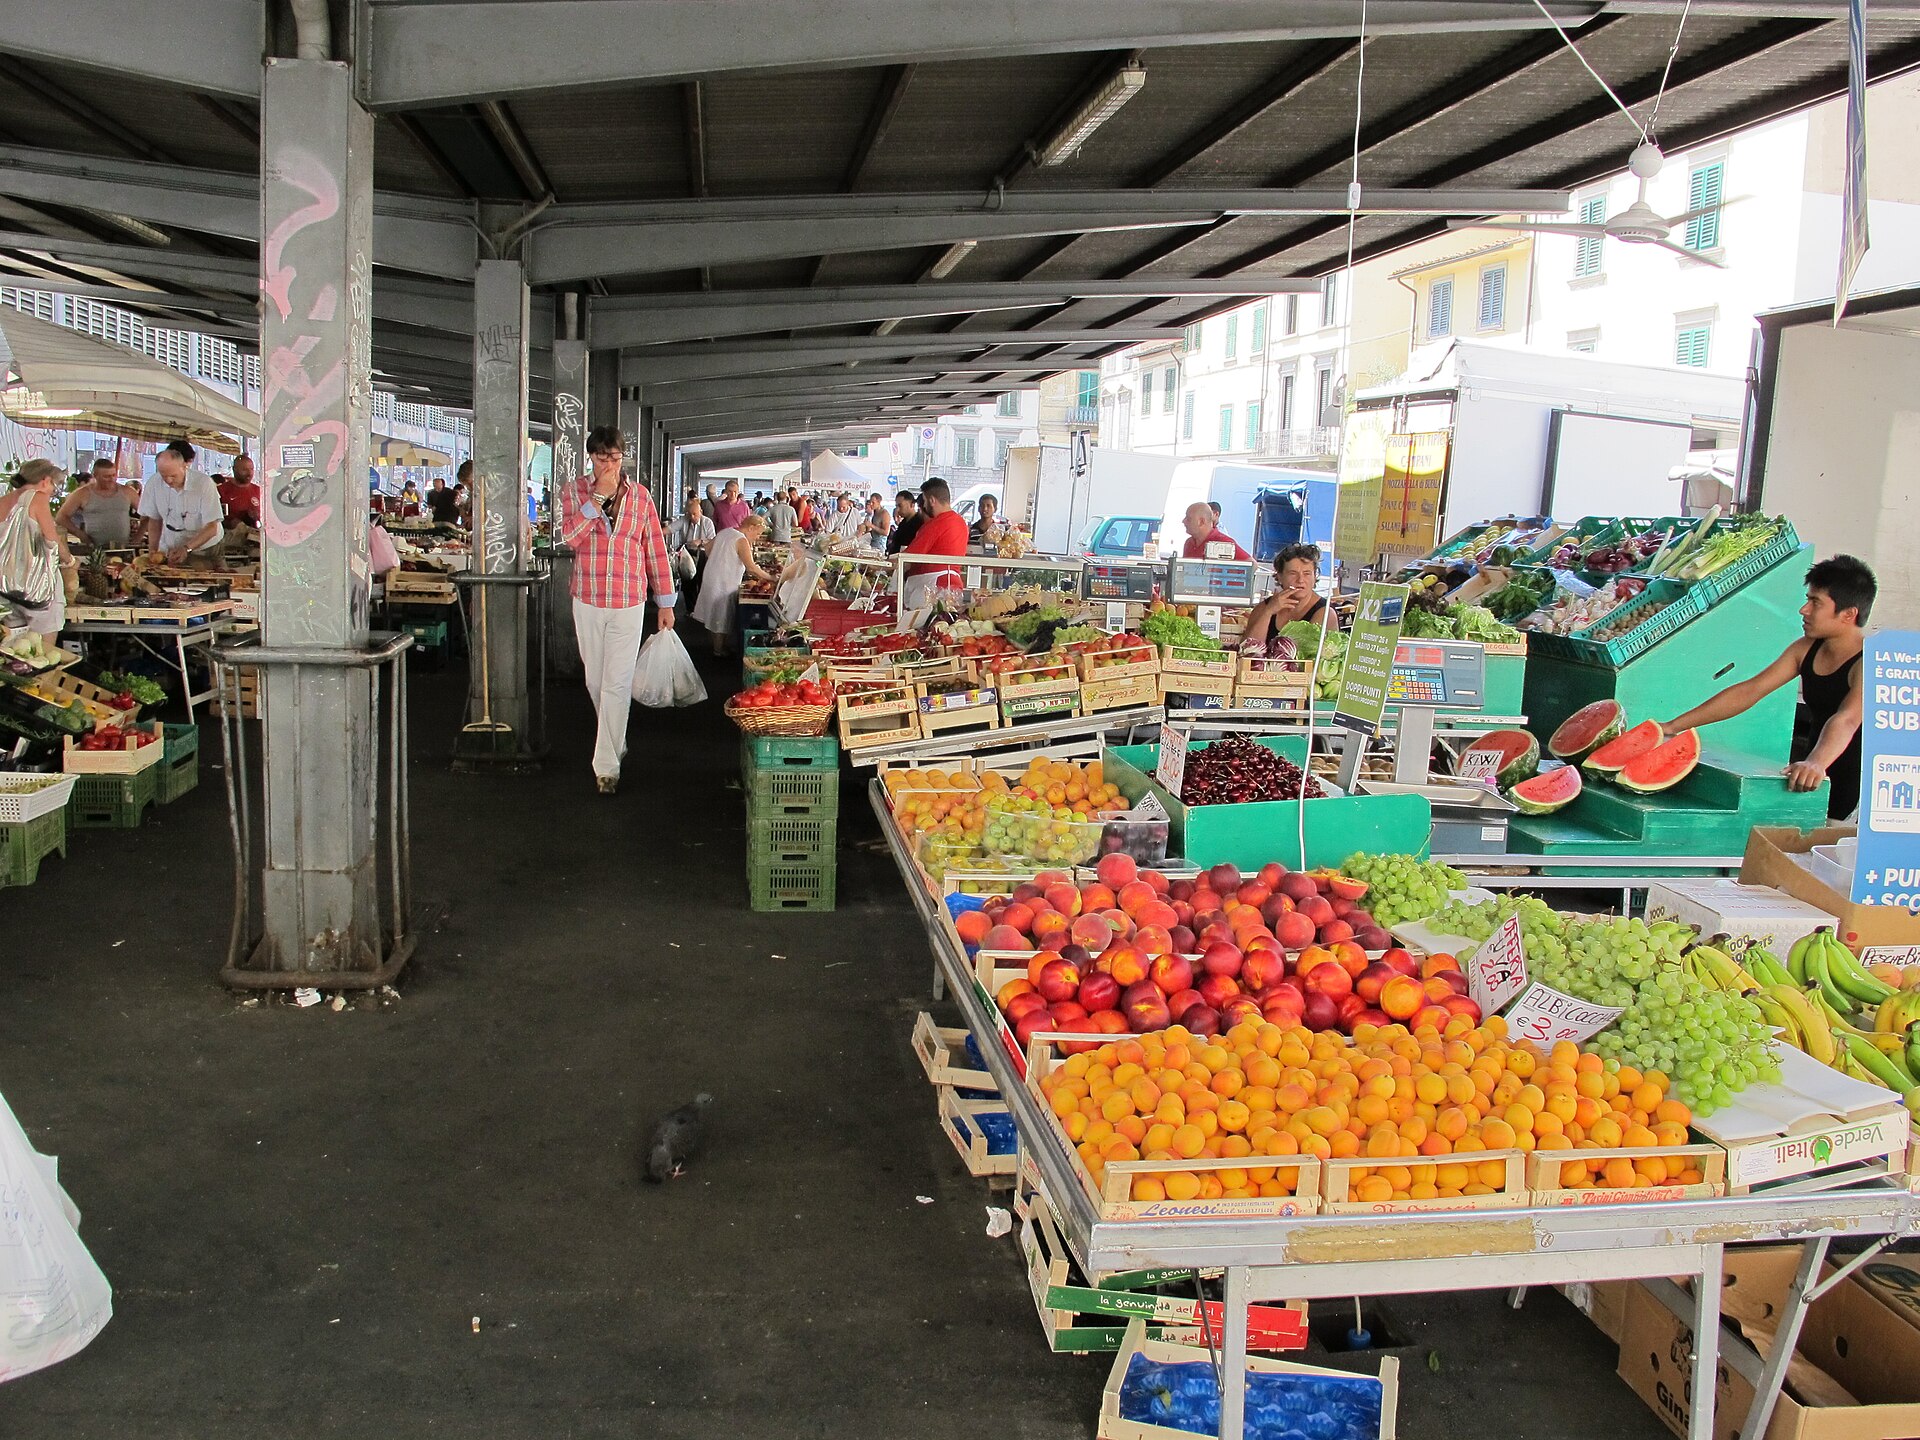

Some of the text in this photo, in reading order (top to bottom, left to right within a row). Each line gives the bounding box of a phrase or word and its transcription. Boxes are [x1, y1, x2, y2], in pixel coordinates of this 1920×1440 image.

[1388, 435, 1426, 448] PRODTTI
[810, 480, 835, 488] Toscana
[844, 482, 871, 490] Mugello
[1358, 598, 1381, 622] X2
[1875, 651, 1891, 662] LA
[1875, 665, 1883, 678] È
[1345, 681, 1381, 698] DOPPI PUNTI
[1875, 710, 1919, 731] SUB
[1878, 762, 1920, 774] SANT'A
[1503, 915, 1525, 988] OFFERTA
[1834, 1126, 1884, 1150] Verde
[1138, 1203, 1219, 1217] Leonesi
[1146, 1272, 1156, 1280] la
[1100, 1295, 1111, 1305] la
[1176, 1305, 1193, 1314] del
[1105, 1334, 1116, 1344] la
[1181, 1333, 1199, 1343] del
